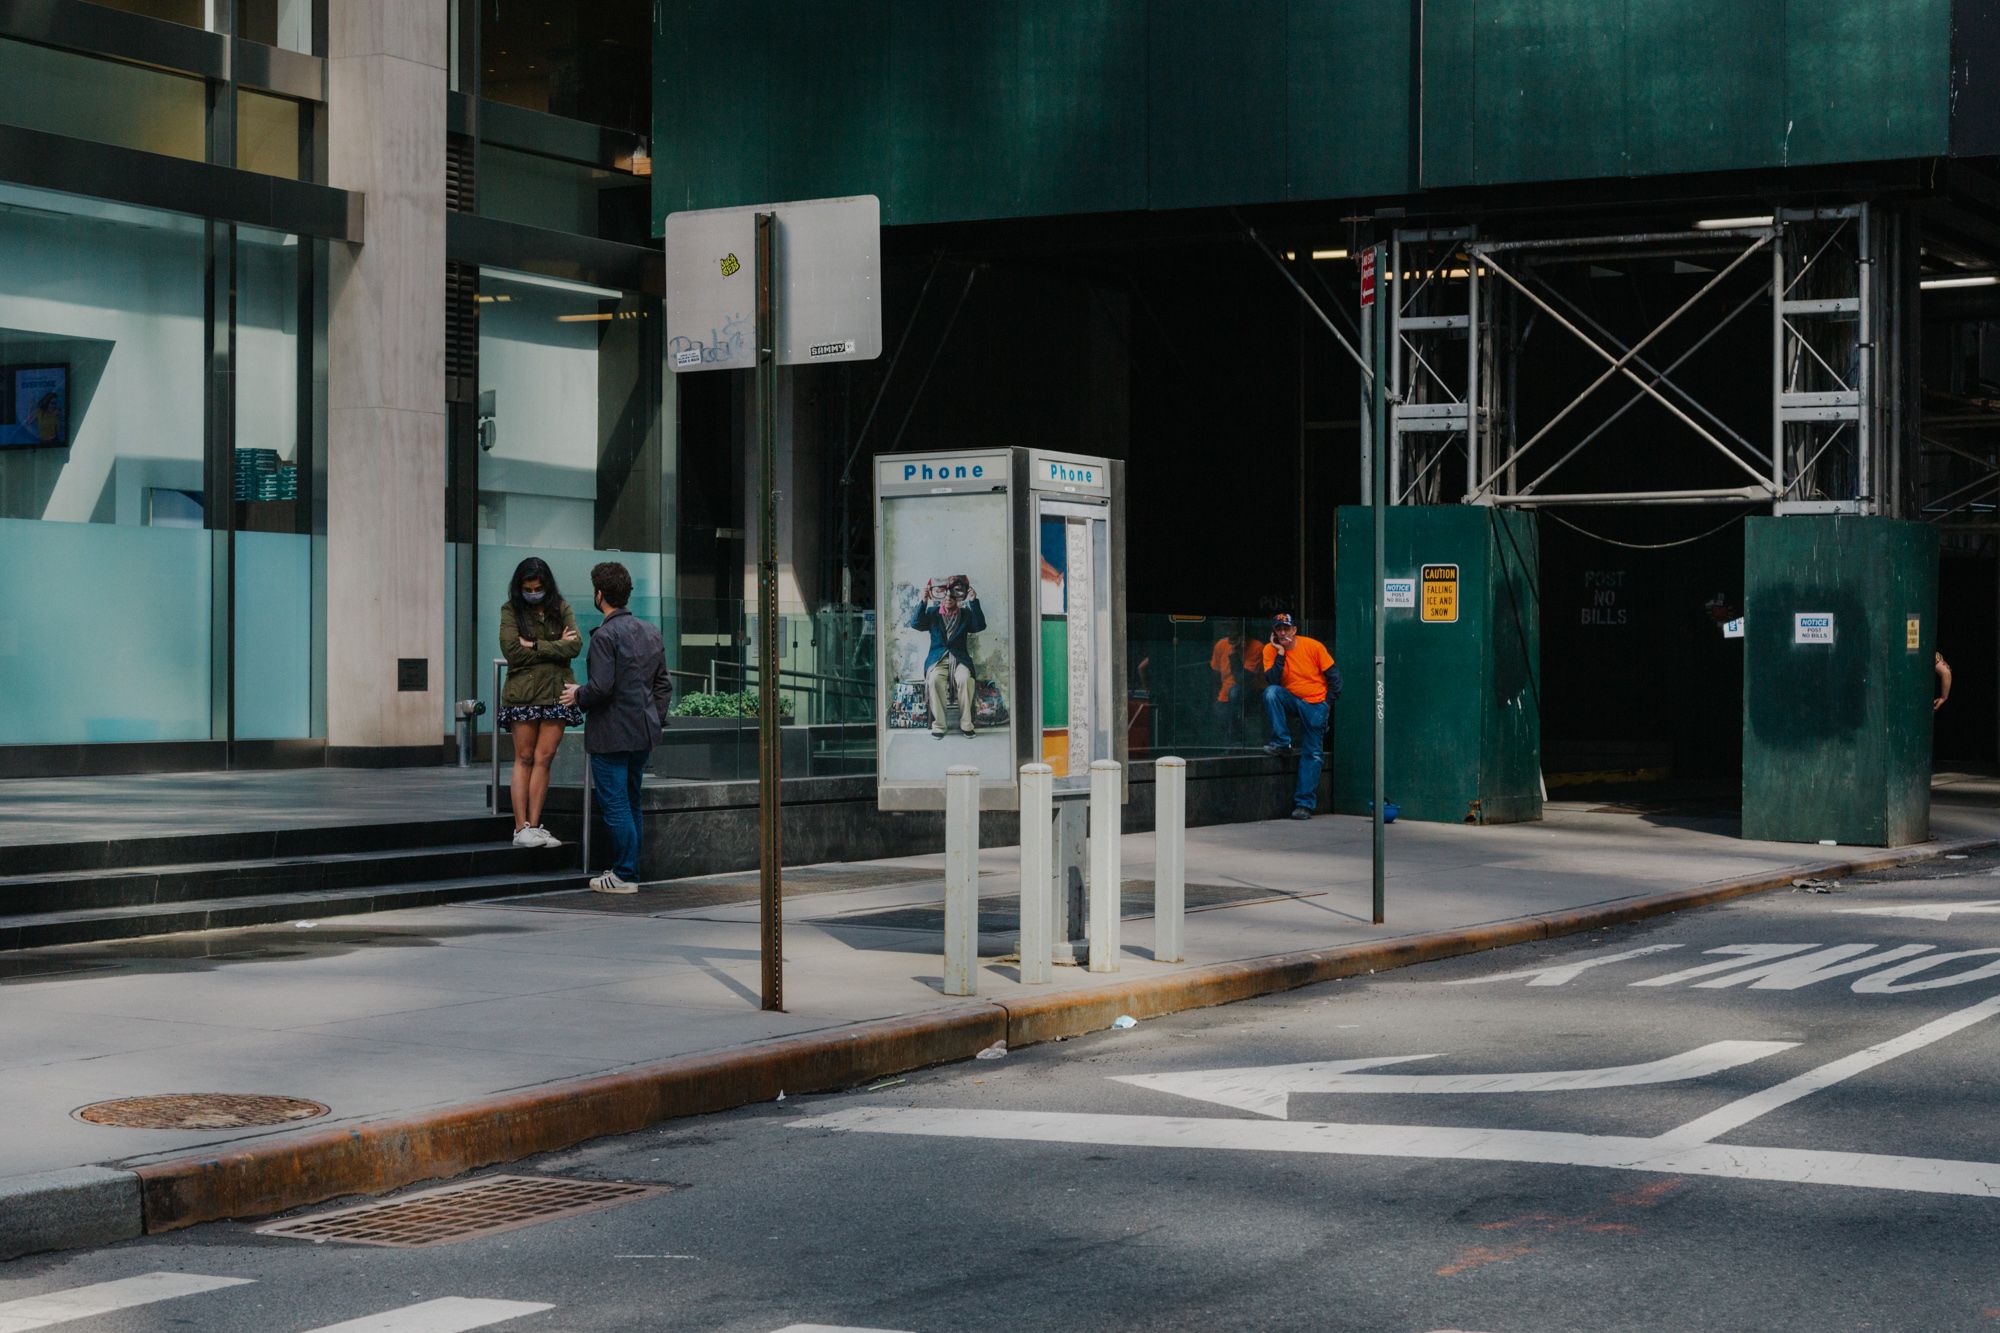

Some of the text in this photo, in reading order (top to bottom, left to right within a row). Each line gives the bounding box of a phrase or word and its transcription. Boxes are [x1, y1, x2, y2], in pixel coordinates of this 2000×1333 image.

[811, 344, 845, 355] SAMMY
[904, 464, 983, 481] Phone
[1051, 463, 1092, 483] Phone
[1425, 568, 1455, 579] CAUTION
[1585, 571, 1626, 587] POST
[1427, 585, 1452, 594] FALLING
[1427, 597, 1452, 605] ICE AND
[1594, 590, 1616, 606] NO
[1431, 608, 1448, 616] SNOW
[1581, 608, 1627, 624] BILLS
